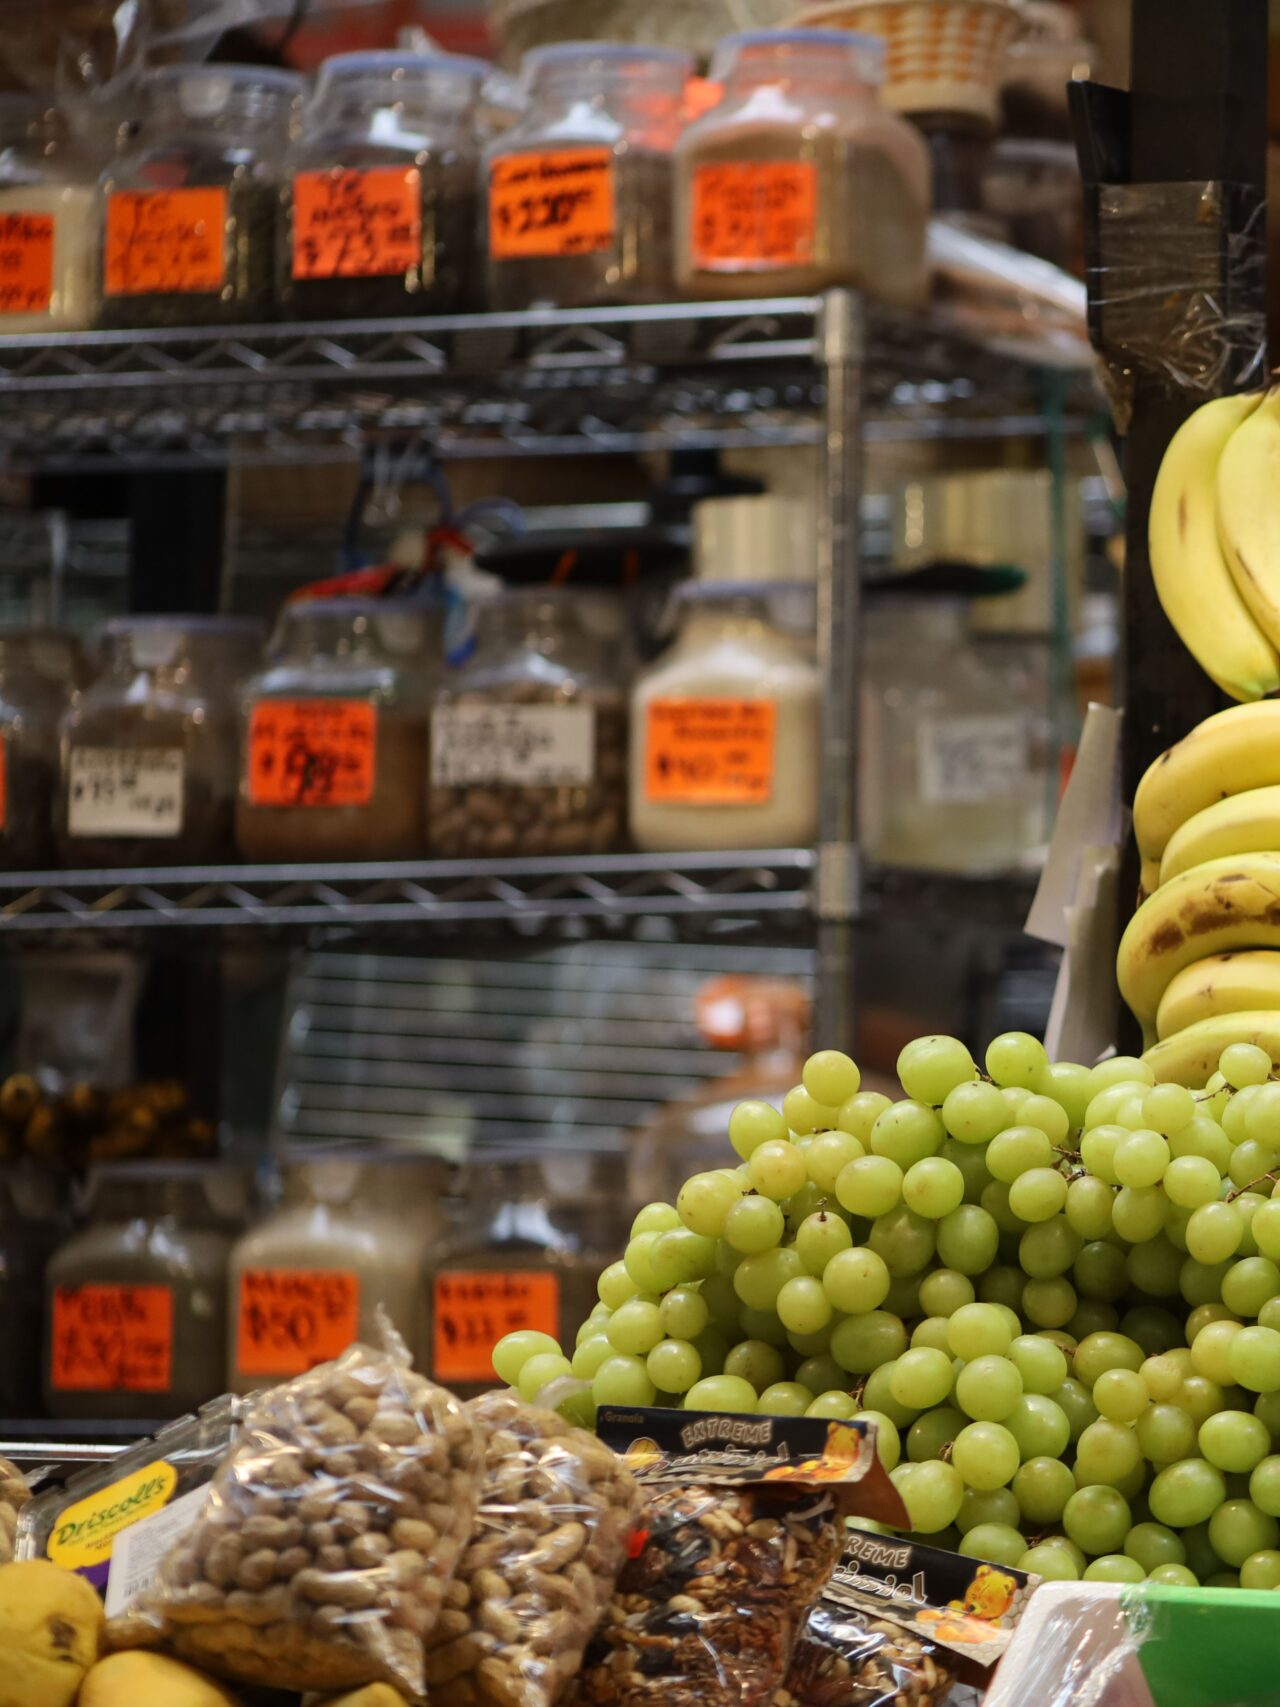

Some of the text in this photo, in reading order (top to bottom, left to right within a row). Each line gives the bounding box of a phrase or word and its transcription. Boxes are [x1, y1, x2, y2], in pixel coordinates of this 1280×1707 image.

[605, 1411, 644, 1424] Granola
[680, 1418, 773, 1449] EXTREME
[56, 1475, 167, 1546] Driscoll's
[844, 1535, 913, 1568] REME
